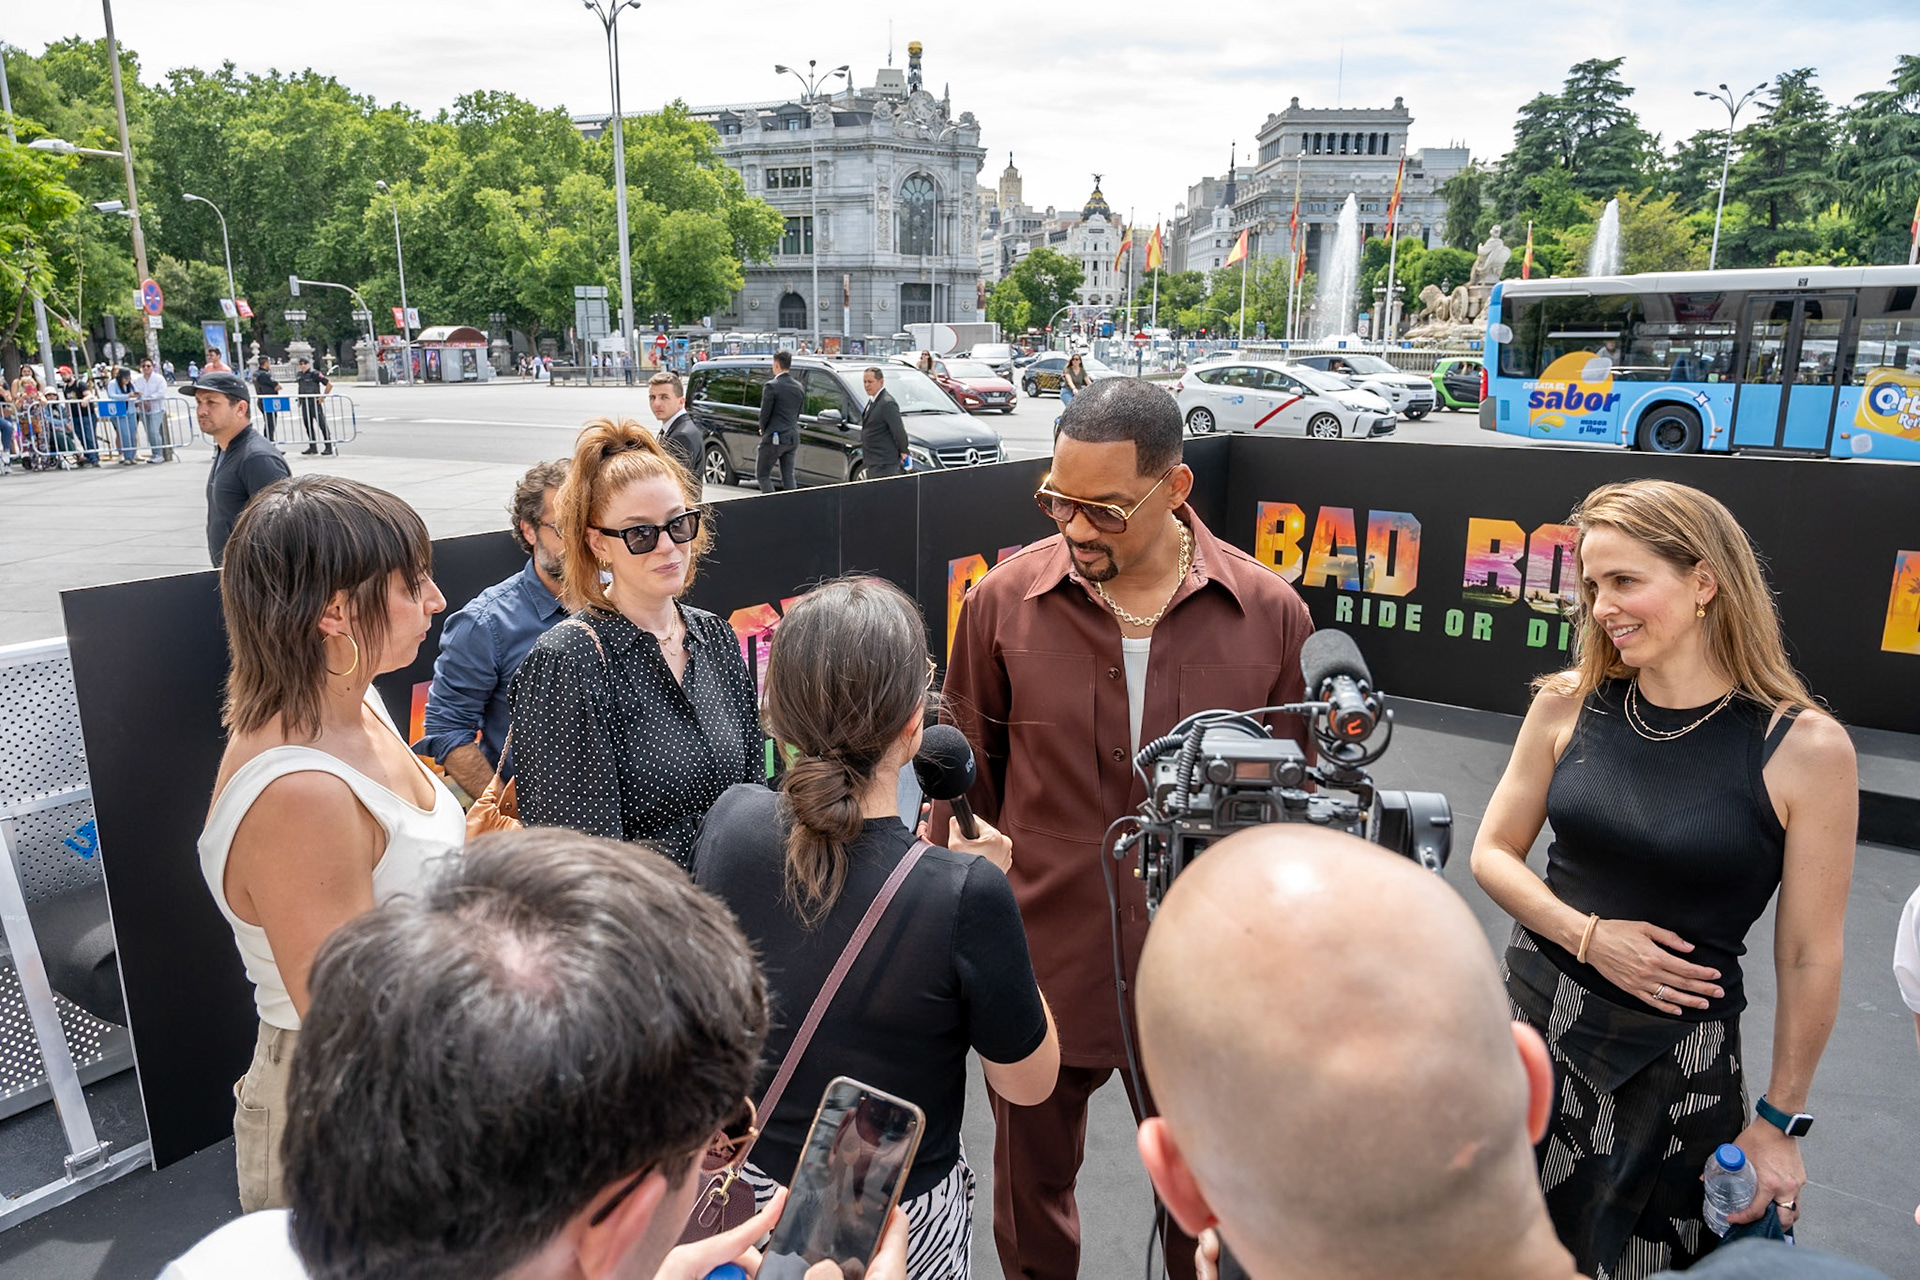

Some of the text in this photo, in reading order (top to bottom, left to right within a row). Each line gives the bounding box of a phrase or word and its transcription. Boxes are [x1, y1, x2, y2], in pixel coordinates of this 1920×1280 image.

[1528, 383, 1621, 412] sabor
[1255, 501, 1580, 615] BAD BO
[1335, 594, 1586, 653] RIDE OR DI
